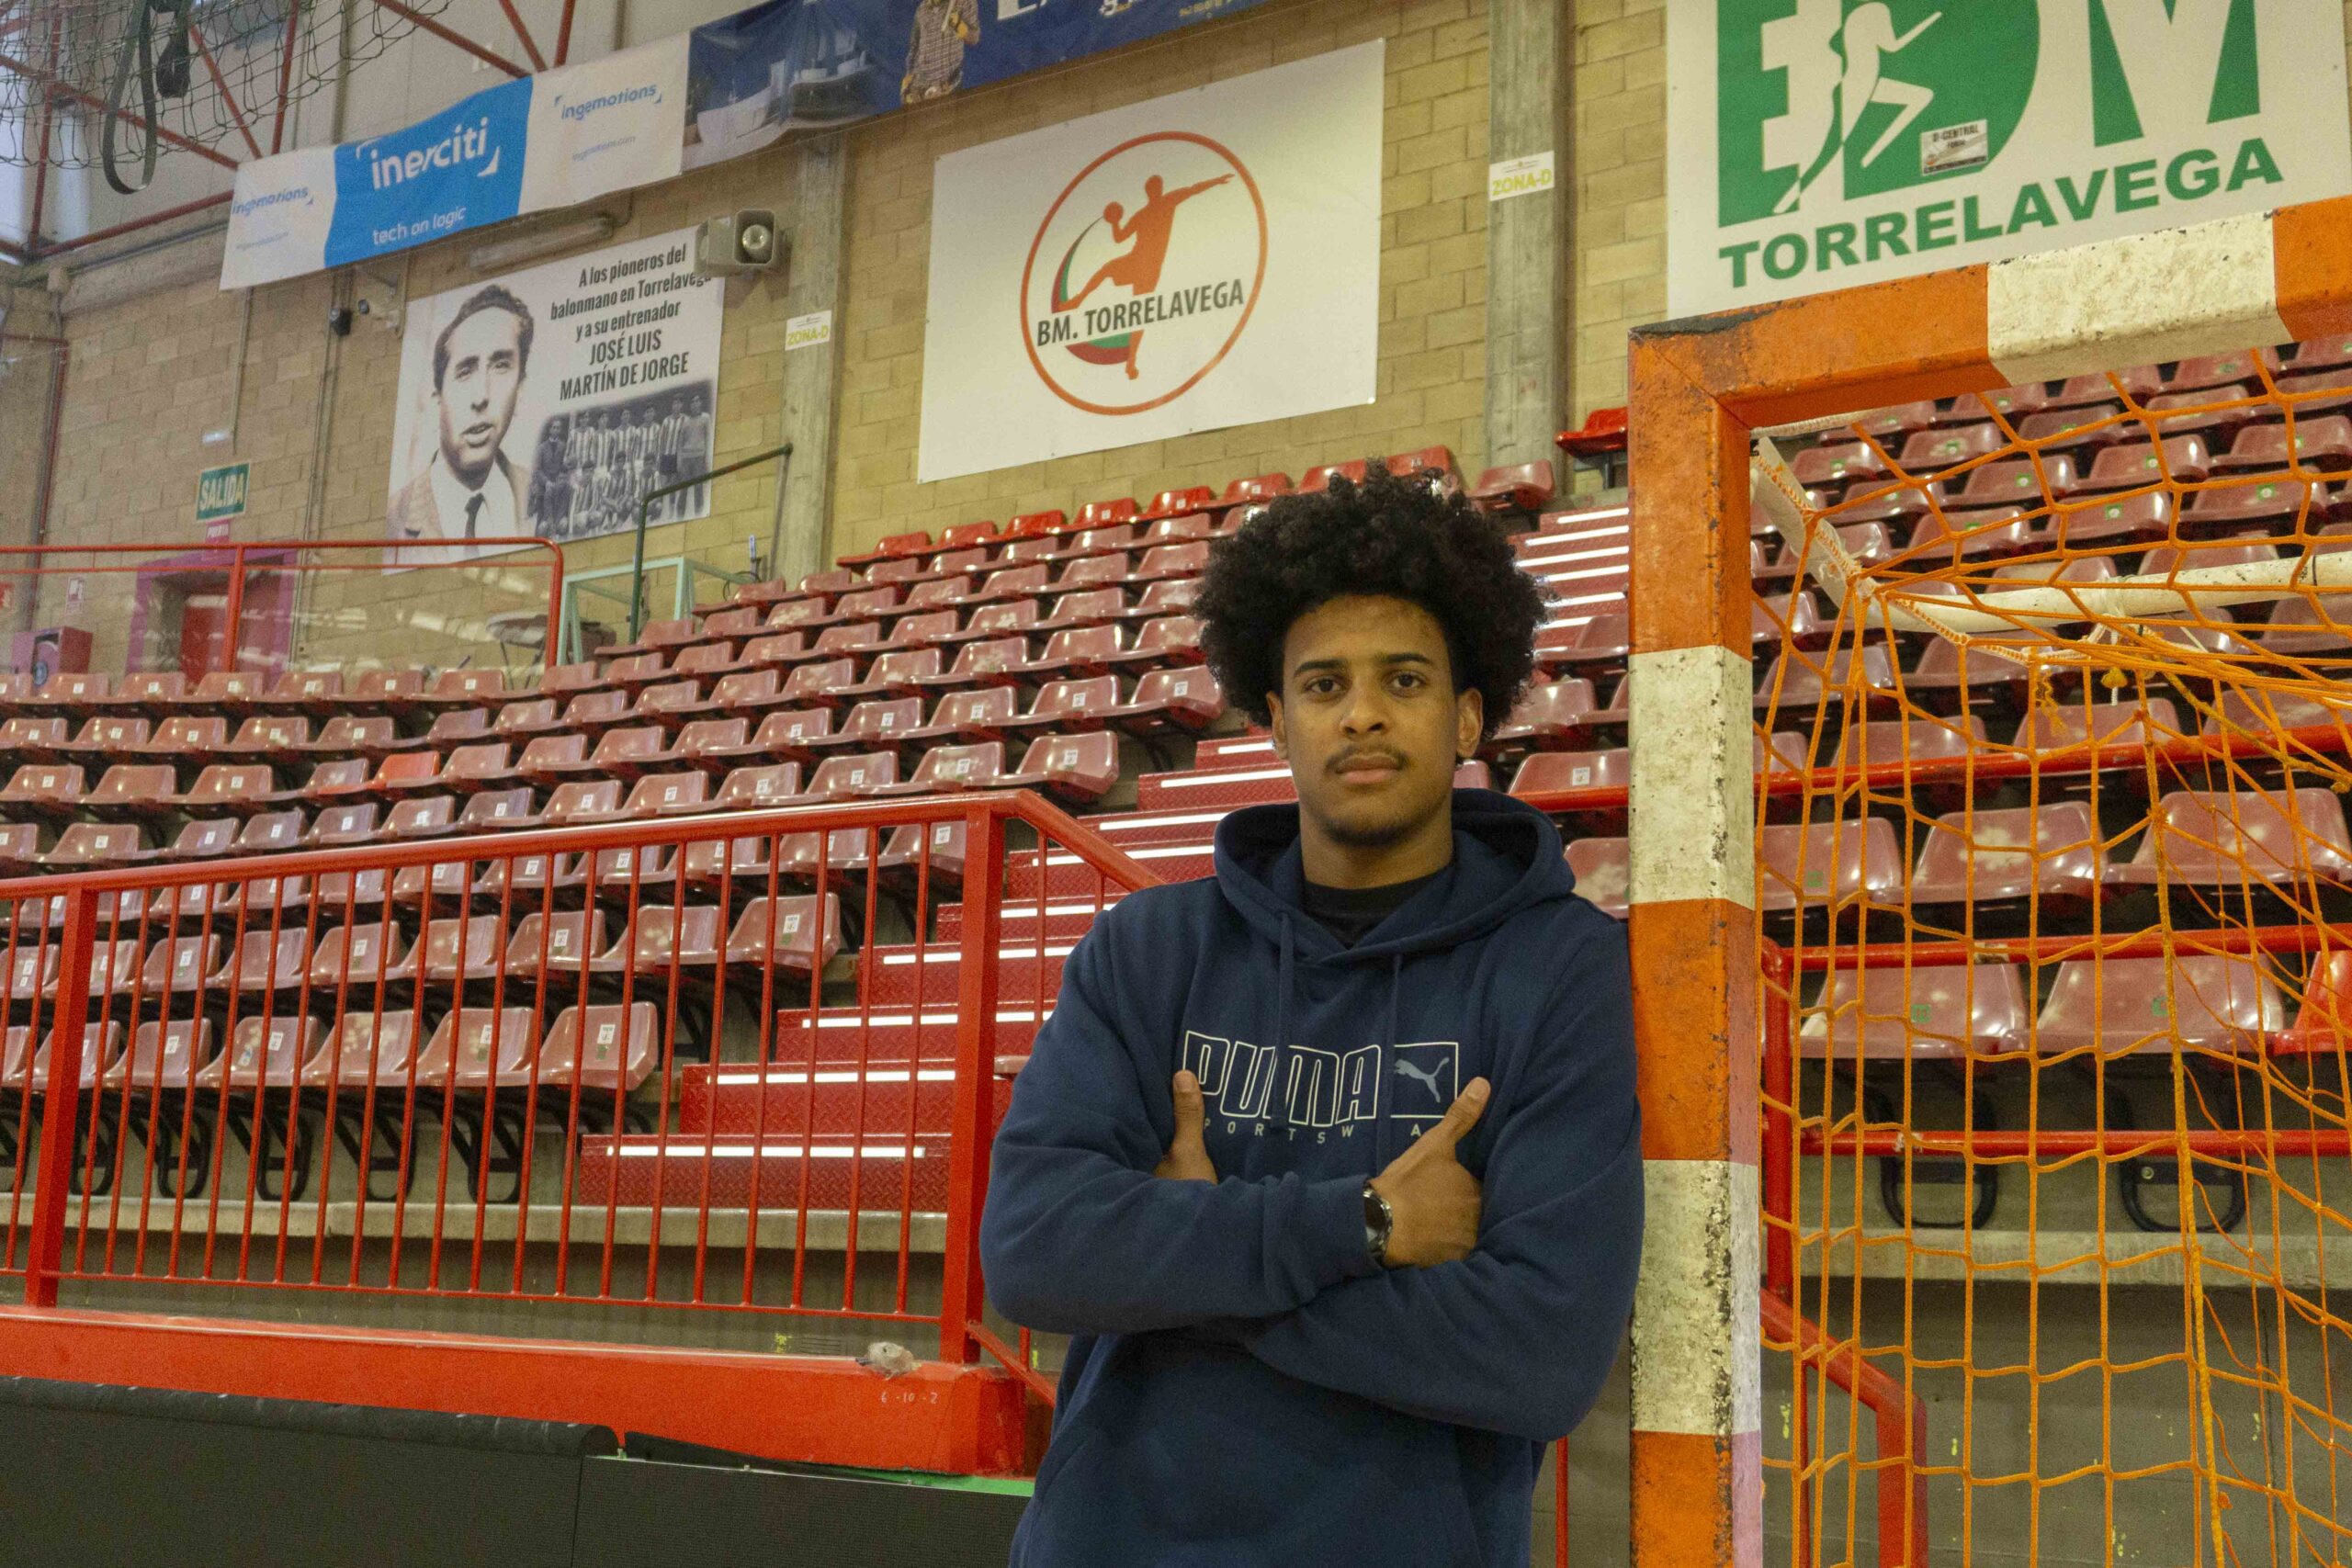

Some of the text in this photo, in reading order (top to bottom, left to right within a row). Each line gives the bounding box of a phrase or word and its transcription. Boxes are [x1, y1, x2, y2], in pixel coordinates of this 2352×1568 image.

[561, 84, 657, 120] ingemotions
[371, 118, 489, 189] inerciti
[373, 207, 467, 245] tech on logic
[1718, 138, 2285, 288] TORRELAVEGA
[578, 243, 686, 288] A los pioneros del
[551, 290, 617, 321] balonmano
[620, 288, 635, 303] en
[575, 300, 682, 344] y a su entrenador
[1037, 278, 1244, 347] BM. TORRELAVEGA
[589, 329, 662, 366] JOSÉ LUIS
[560, 351, 690, 401] MARTÍN DE JORGE
[199, 472, 244, 512] SALIDA
